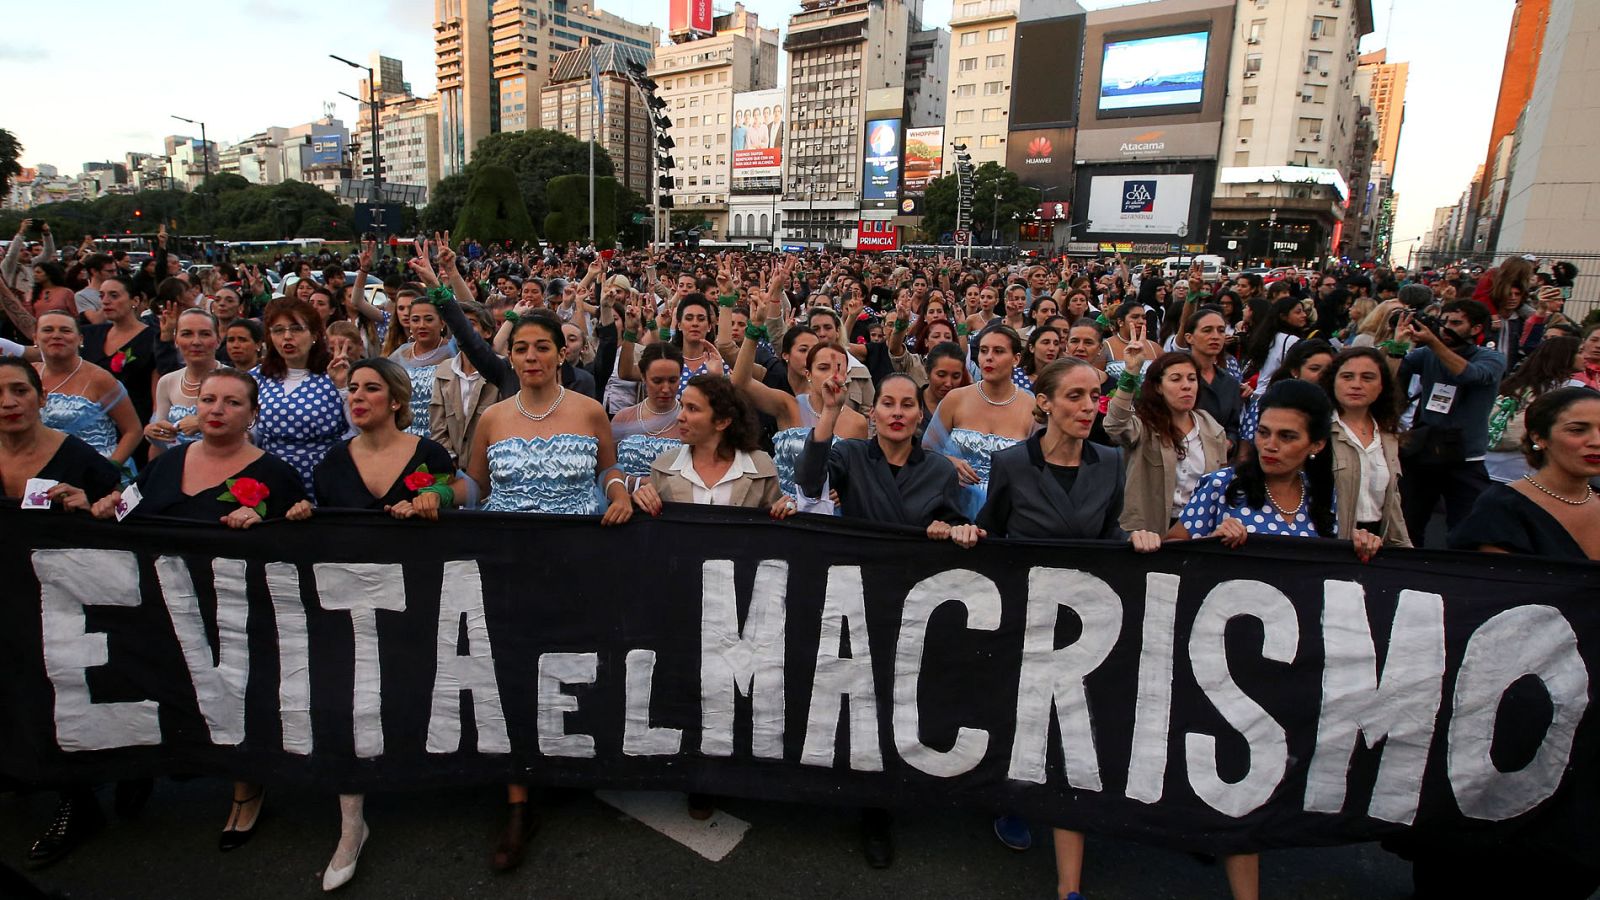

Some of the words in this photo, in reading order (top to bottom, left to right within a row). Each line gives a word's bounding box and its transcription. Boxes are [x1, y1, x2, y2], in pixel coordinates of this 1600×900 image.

[1120, 142, 1164, 151] Atacama
[1126, 191, 1151, 201] CAJA
[860, 237, 893, 245] PRIMICIA
[1273, 241, 1298, 250] TOSTADO
[31, 549, 511, 758] EVITA
[538, 649, 682, 758] EL
[700, 559, 1589, 826] MACRISMO
